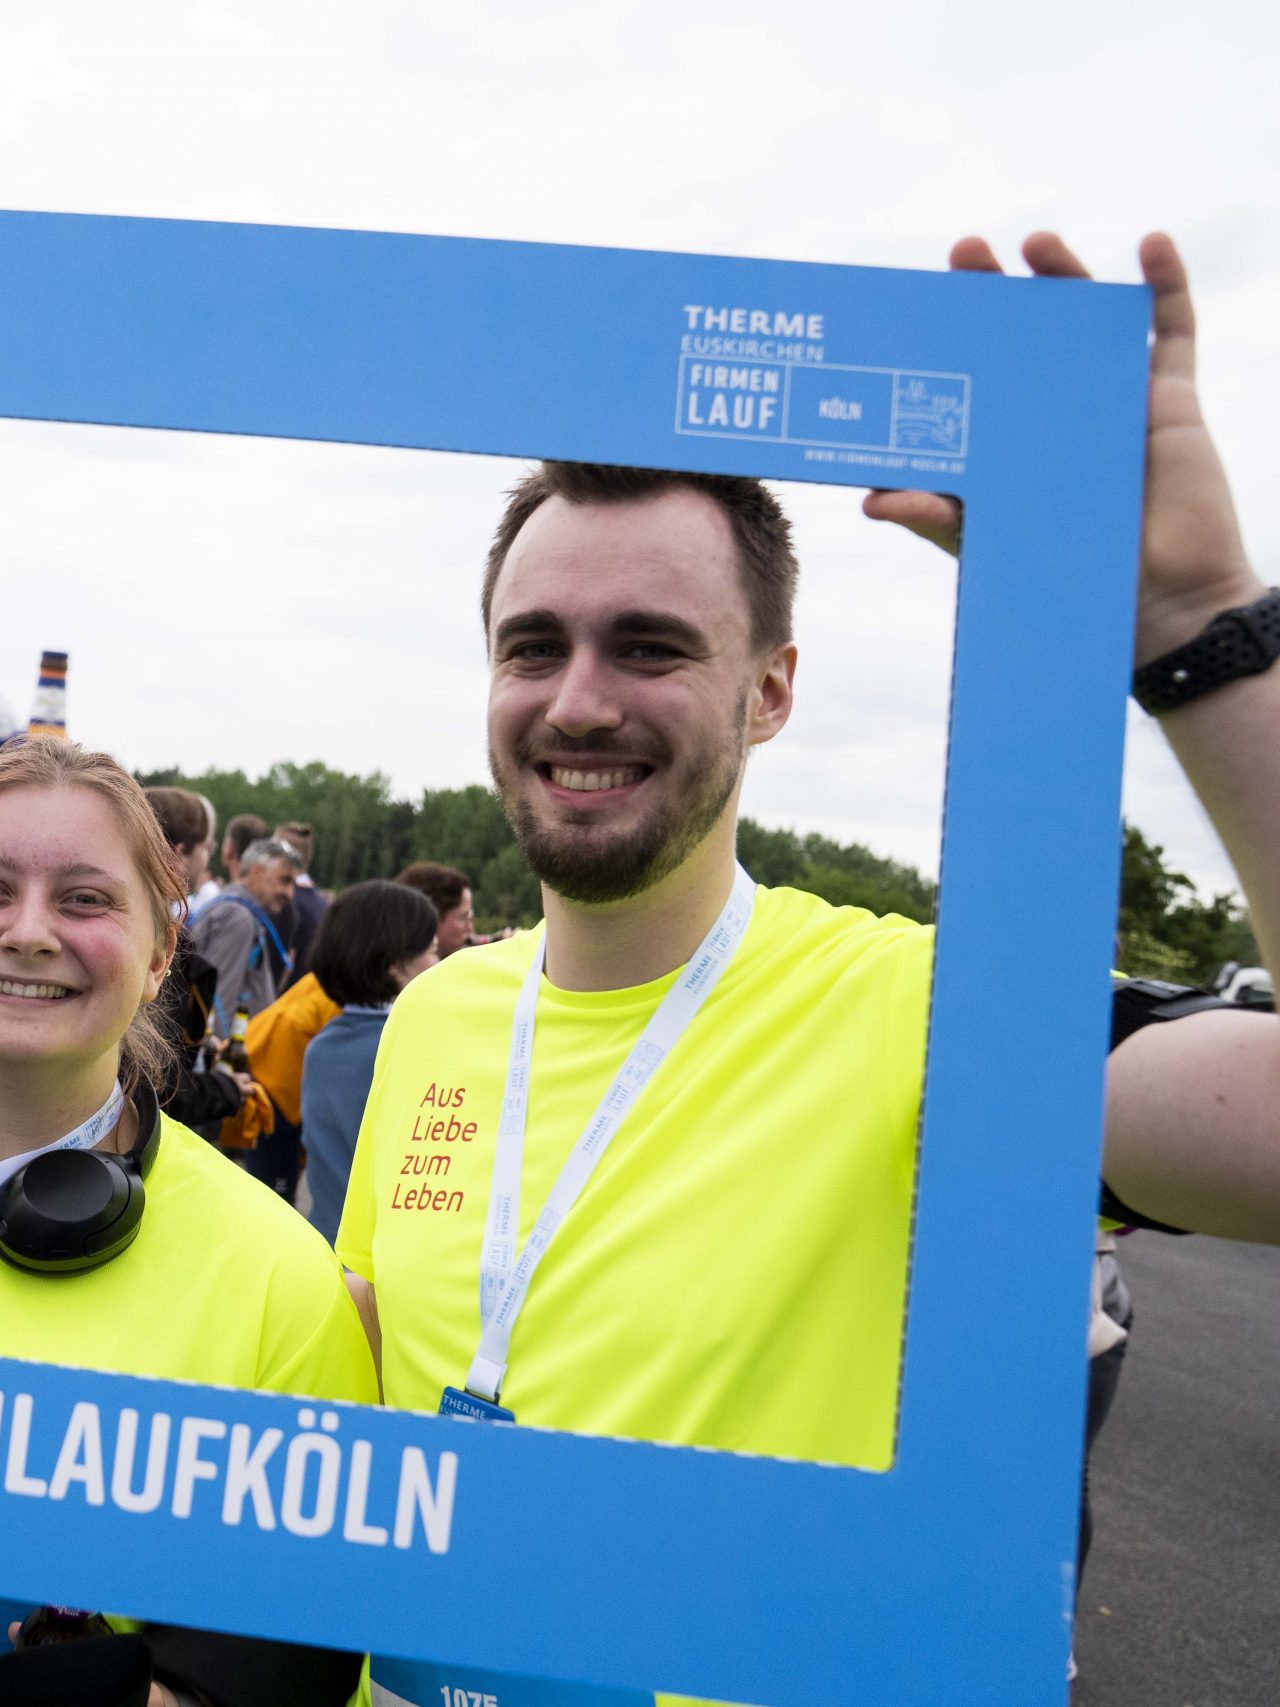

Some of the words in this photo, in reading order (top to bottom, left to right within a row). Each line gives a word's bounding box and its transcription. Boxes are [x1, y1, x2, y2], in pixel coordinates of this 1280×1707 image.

[683, 304, 825, 340] THERME
[680, 334, 825, 362] EUSKIRCHEN
[691, 363, 780, 393] FIRMEN
[687, 391, 778, 430] LAUF
[818, 396, 863, 421] KÖLN
[684, 954, 712, 990] THERME
[420, 1082, 466, 1108] Aus
[411, 1114, 478, 1142] Liebe
[400, 1155, 451, 1176] zum
[391, 1182, 464, 1212] Leben
[443, 1394, 486, 1420] THERME
